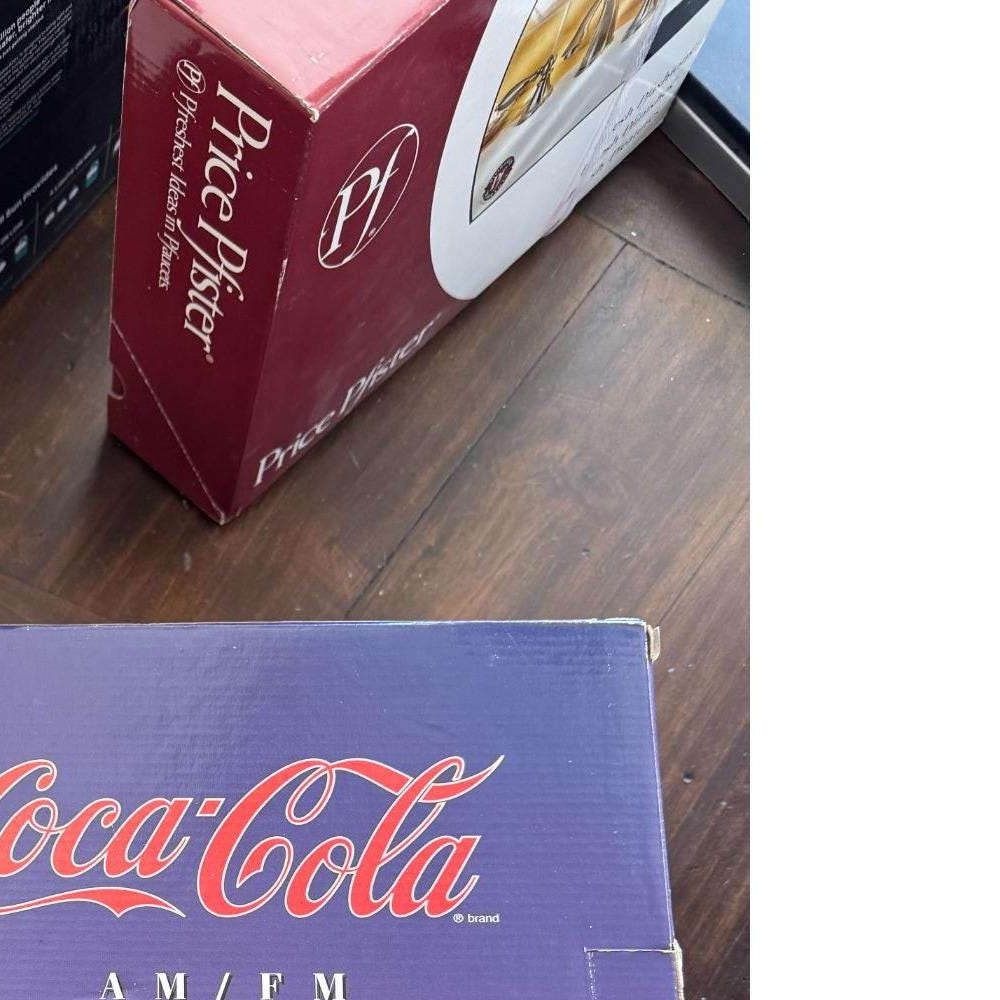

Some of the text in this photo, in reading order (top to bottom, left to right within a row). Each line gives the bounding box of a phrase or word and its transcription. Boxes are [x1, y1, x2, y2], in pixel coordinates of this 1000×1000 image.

[18, 1, 47, 32] brighter
[172, 90, 198, 172] Pfreshest
[166, 174, 188, 216] Ideas
[176, 81, 273, 354] Price Pfister
[164, 213, 177, 233] in
[157, 232, 181, 291] Pfaucets
[253, 410, 336, 488] Price
[467, 913, 500, 923] brand
